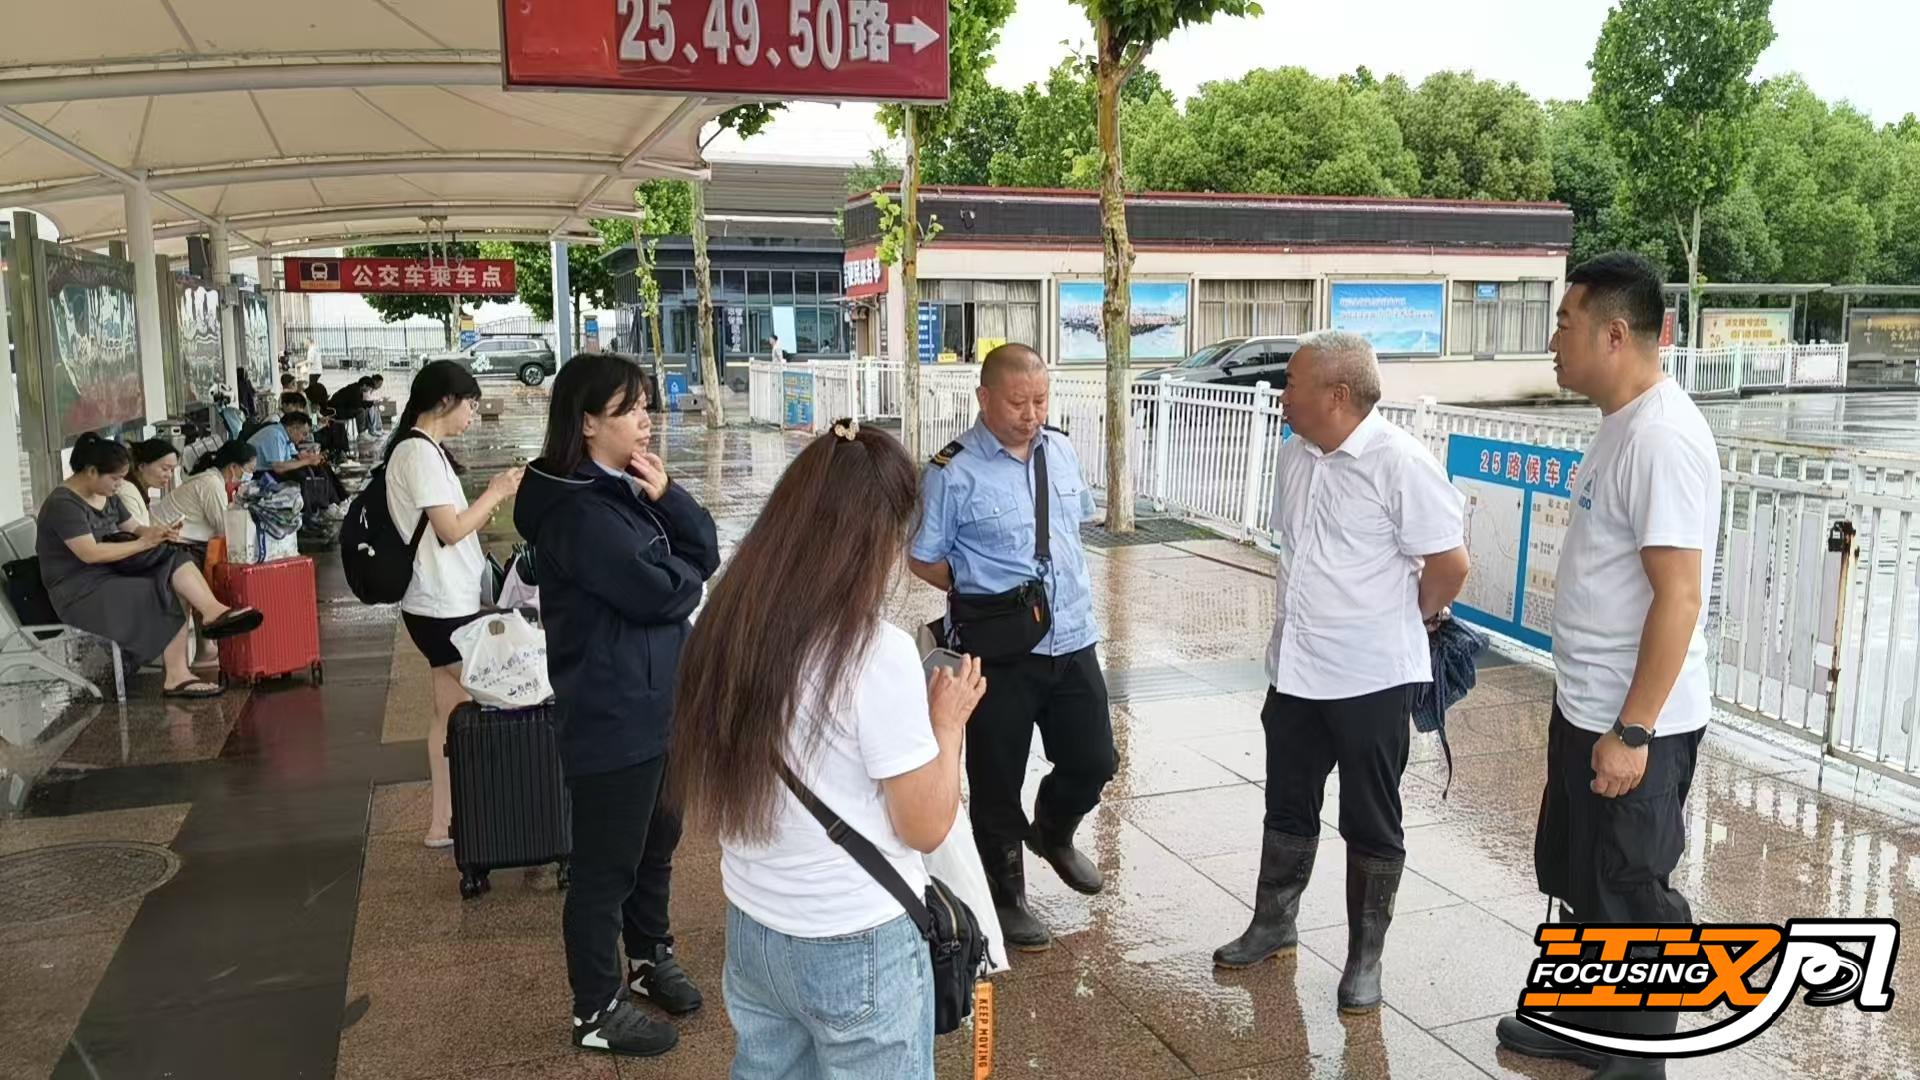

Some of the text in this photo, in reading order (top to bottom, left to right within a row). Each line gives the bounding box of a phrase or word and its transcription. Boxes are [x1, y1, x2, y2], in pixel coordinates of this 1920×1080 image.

[351, 264, 503, 288] 公交车乘车点
[977, 998, 989, 1068] KEEP MOVING
